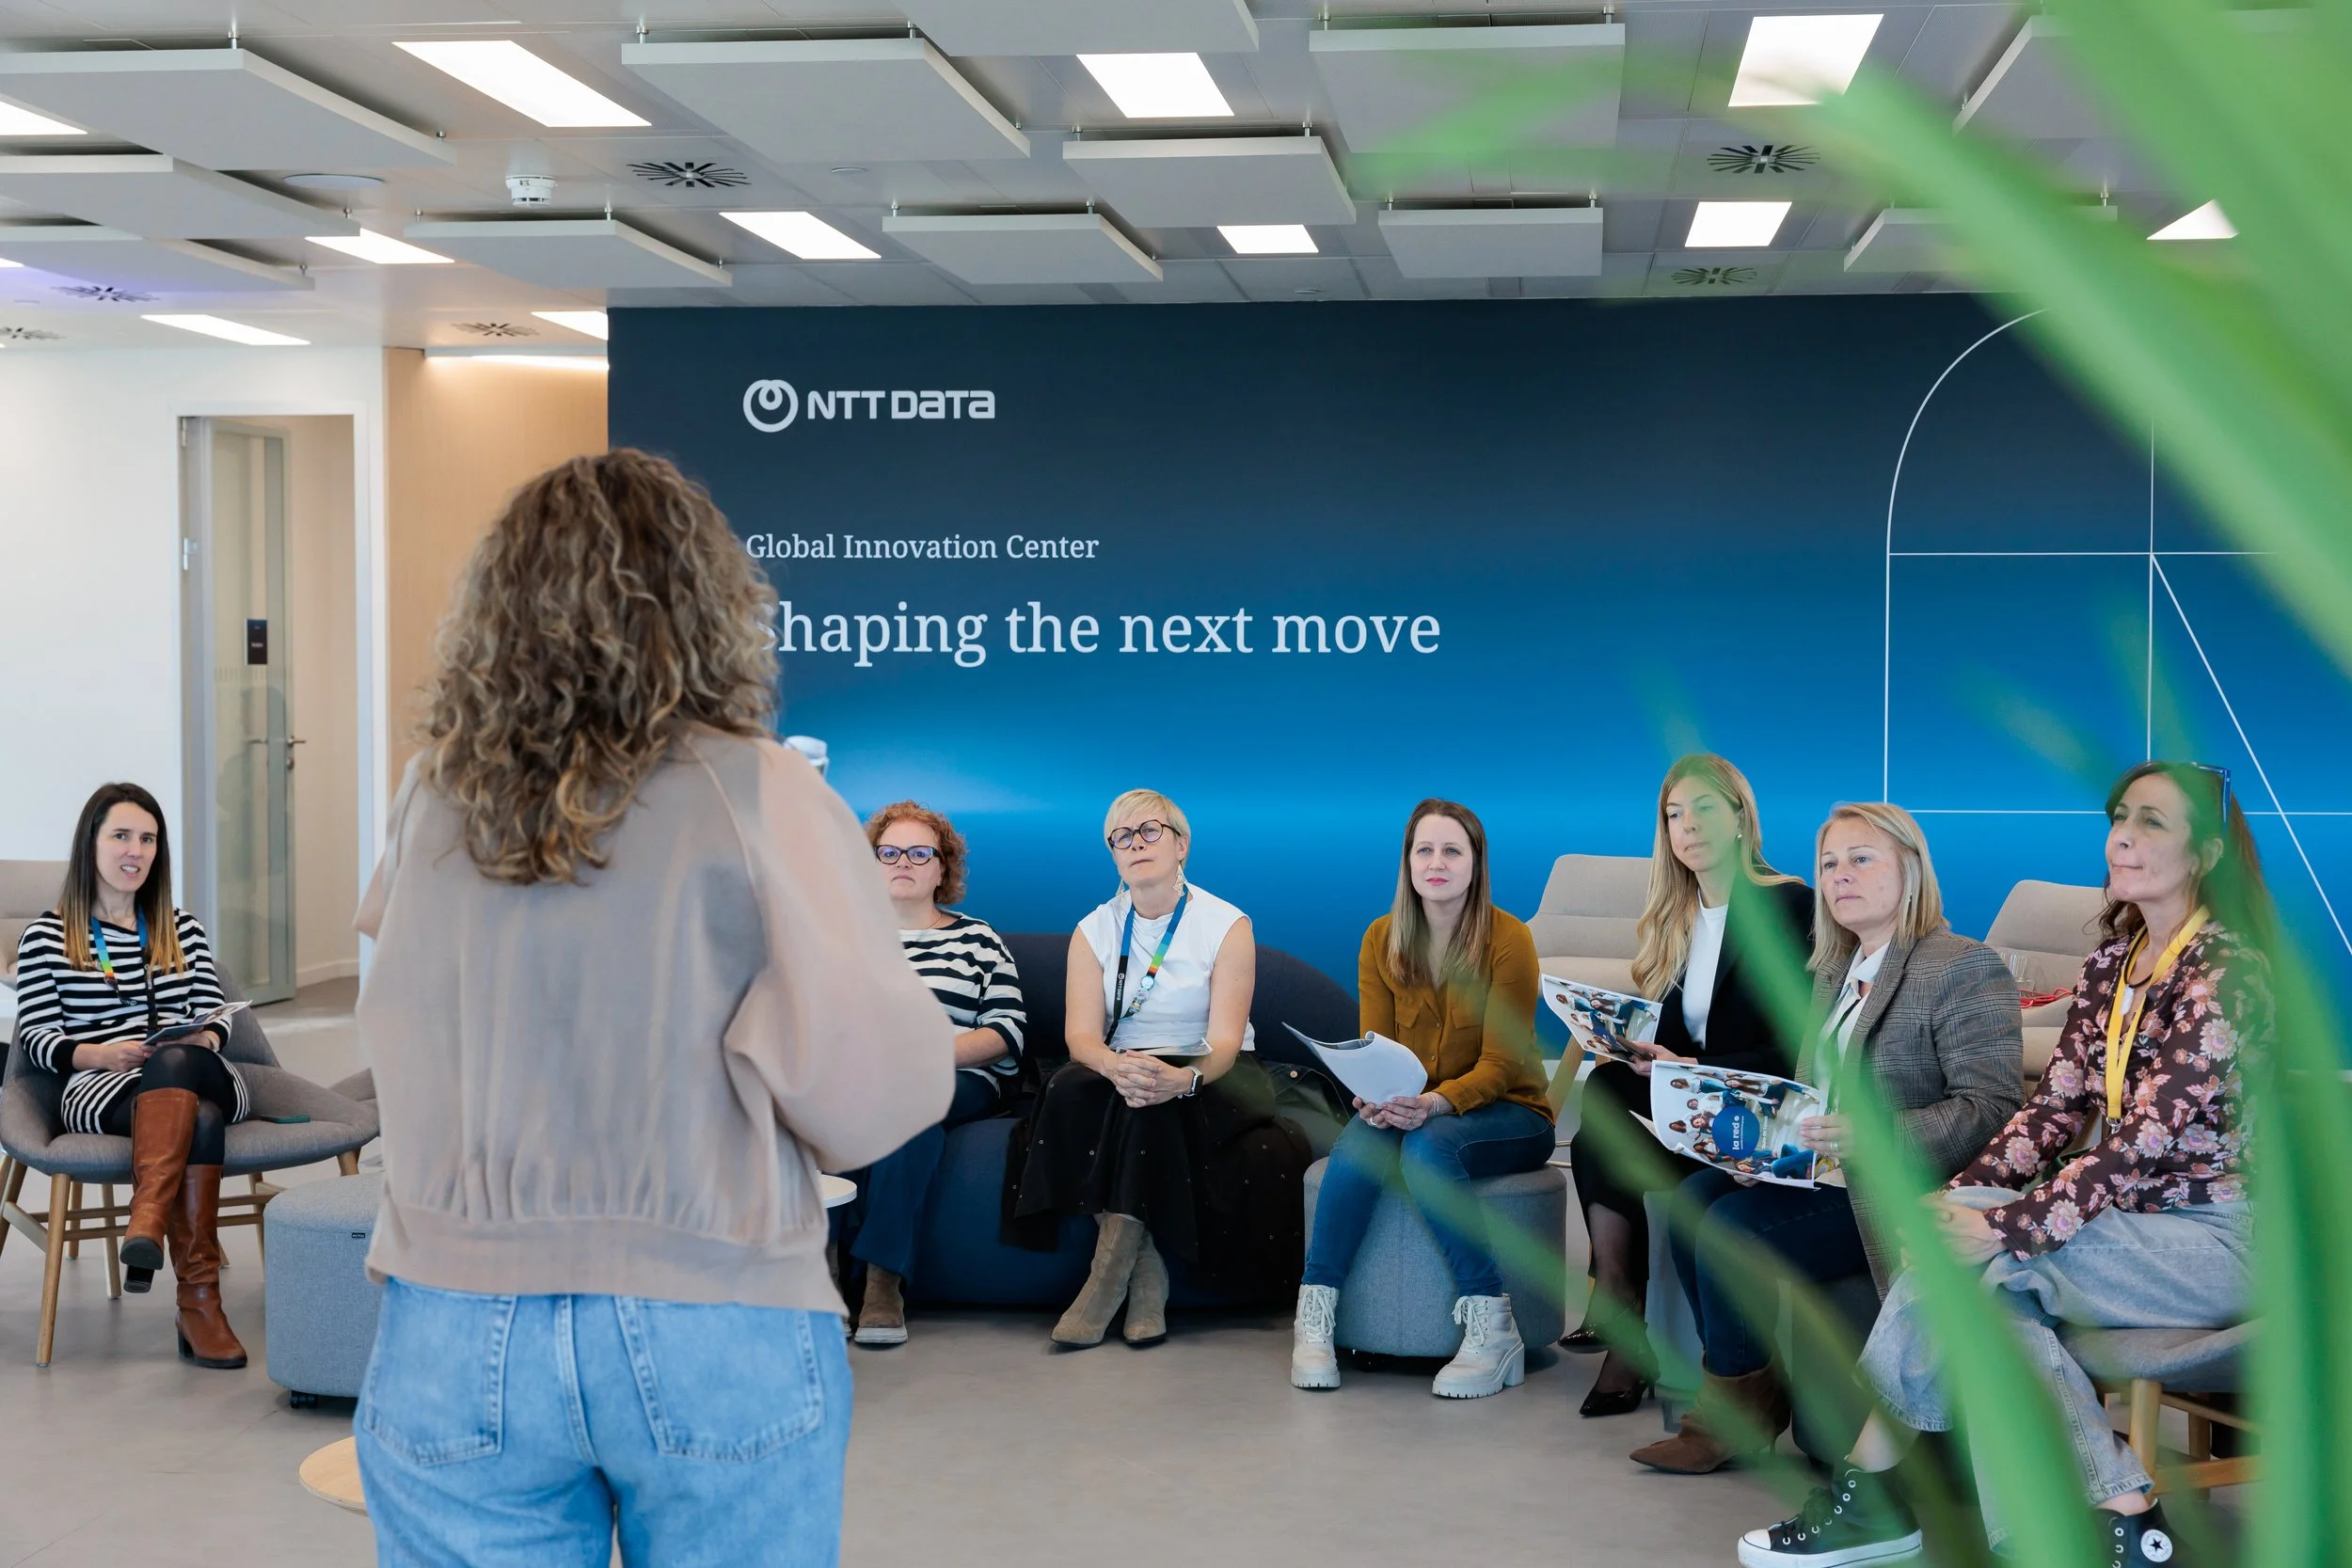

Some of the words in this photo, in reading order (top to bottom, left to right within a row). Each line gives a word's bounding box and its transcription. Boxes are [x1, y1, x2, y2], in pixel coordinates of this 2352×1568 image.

[807, 390, 886, 420] NTT
[745, 533, 836, 559] Global
[843, 533, 998, 559] Innovation
[1006, 534, 1100, 559] Center
[1005, 601, 1100, 653] the
[1119, 608, 1253, 653] next
[1272, 615, 1440, 654] move
[1732, 1141, 1740, 1150] la
